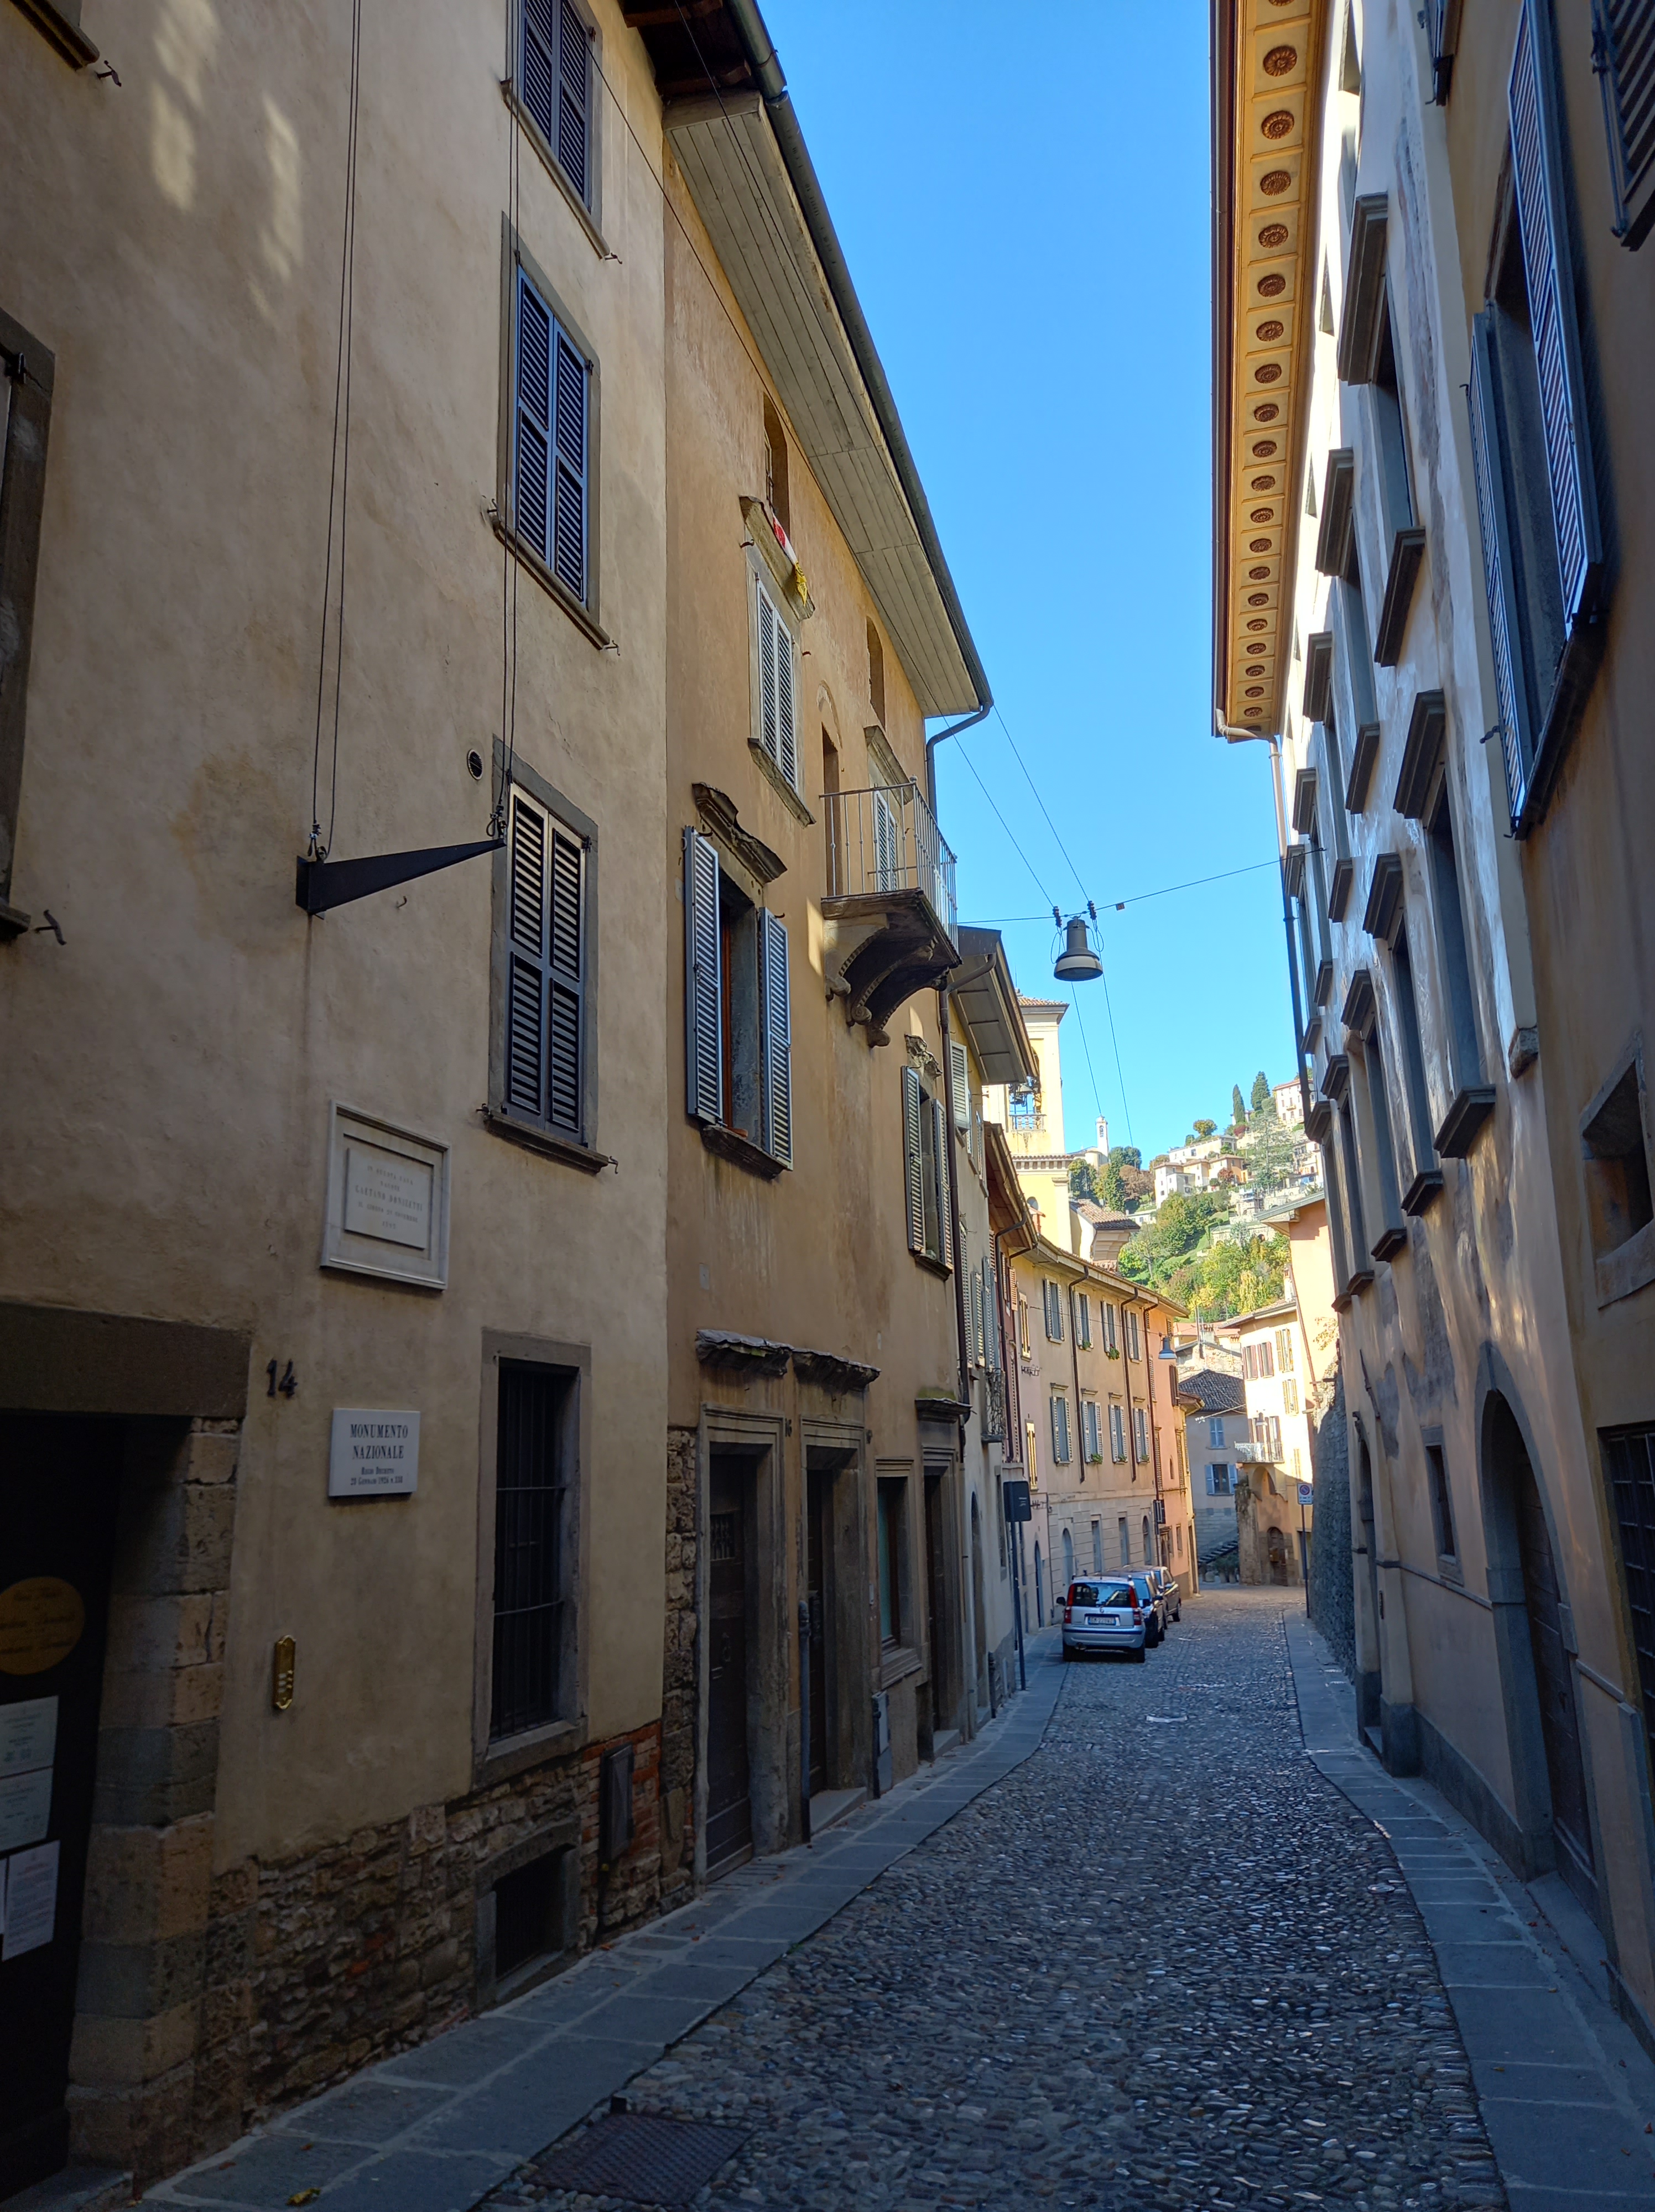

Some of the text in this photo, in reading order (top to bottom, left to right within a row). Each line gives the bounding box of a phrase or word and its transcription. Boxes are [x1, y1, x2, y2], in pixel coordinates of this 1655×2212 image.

[355, 1185, 423, 1212] GAETANO DONIZETTI
[266, 1359, 298, 1399] 14
[350, 1423, 408, 1439] MONUMENTO
[352, 1444, 404, 1460] NAZIONALE
